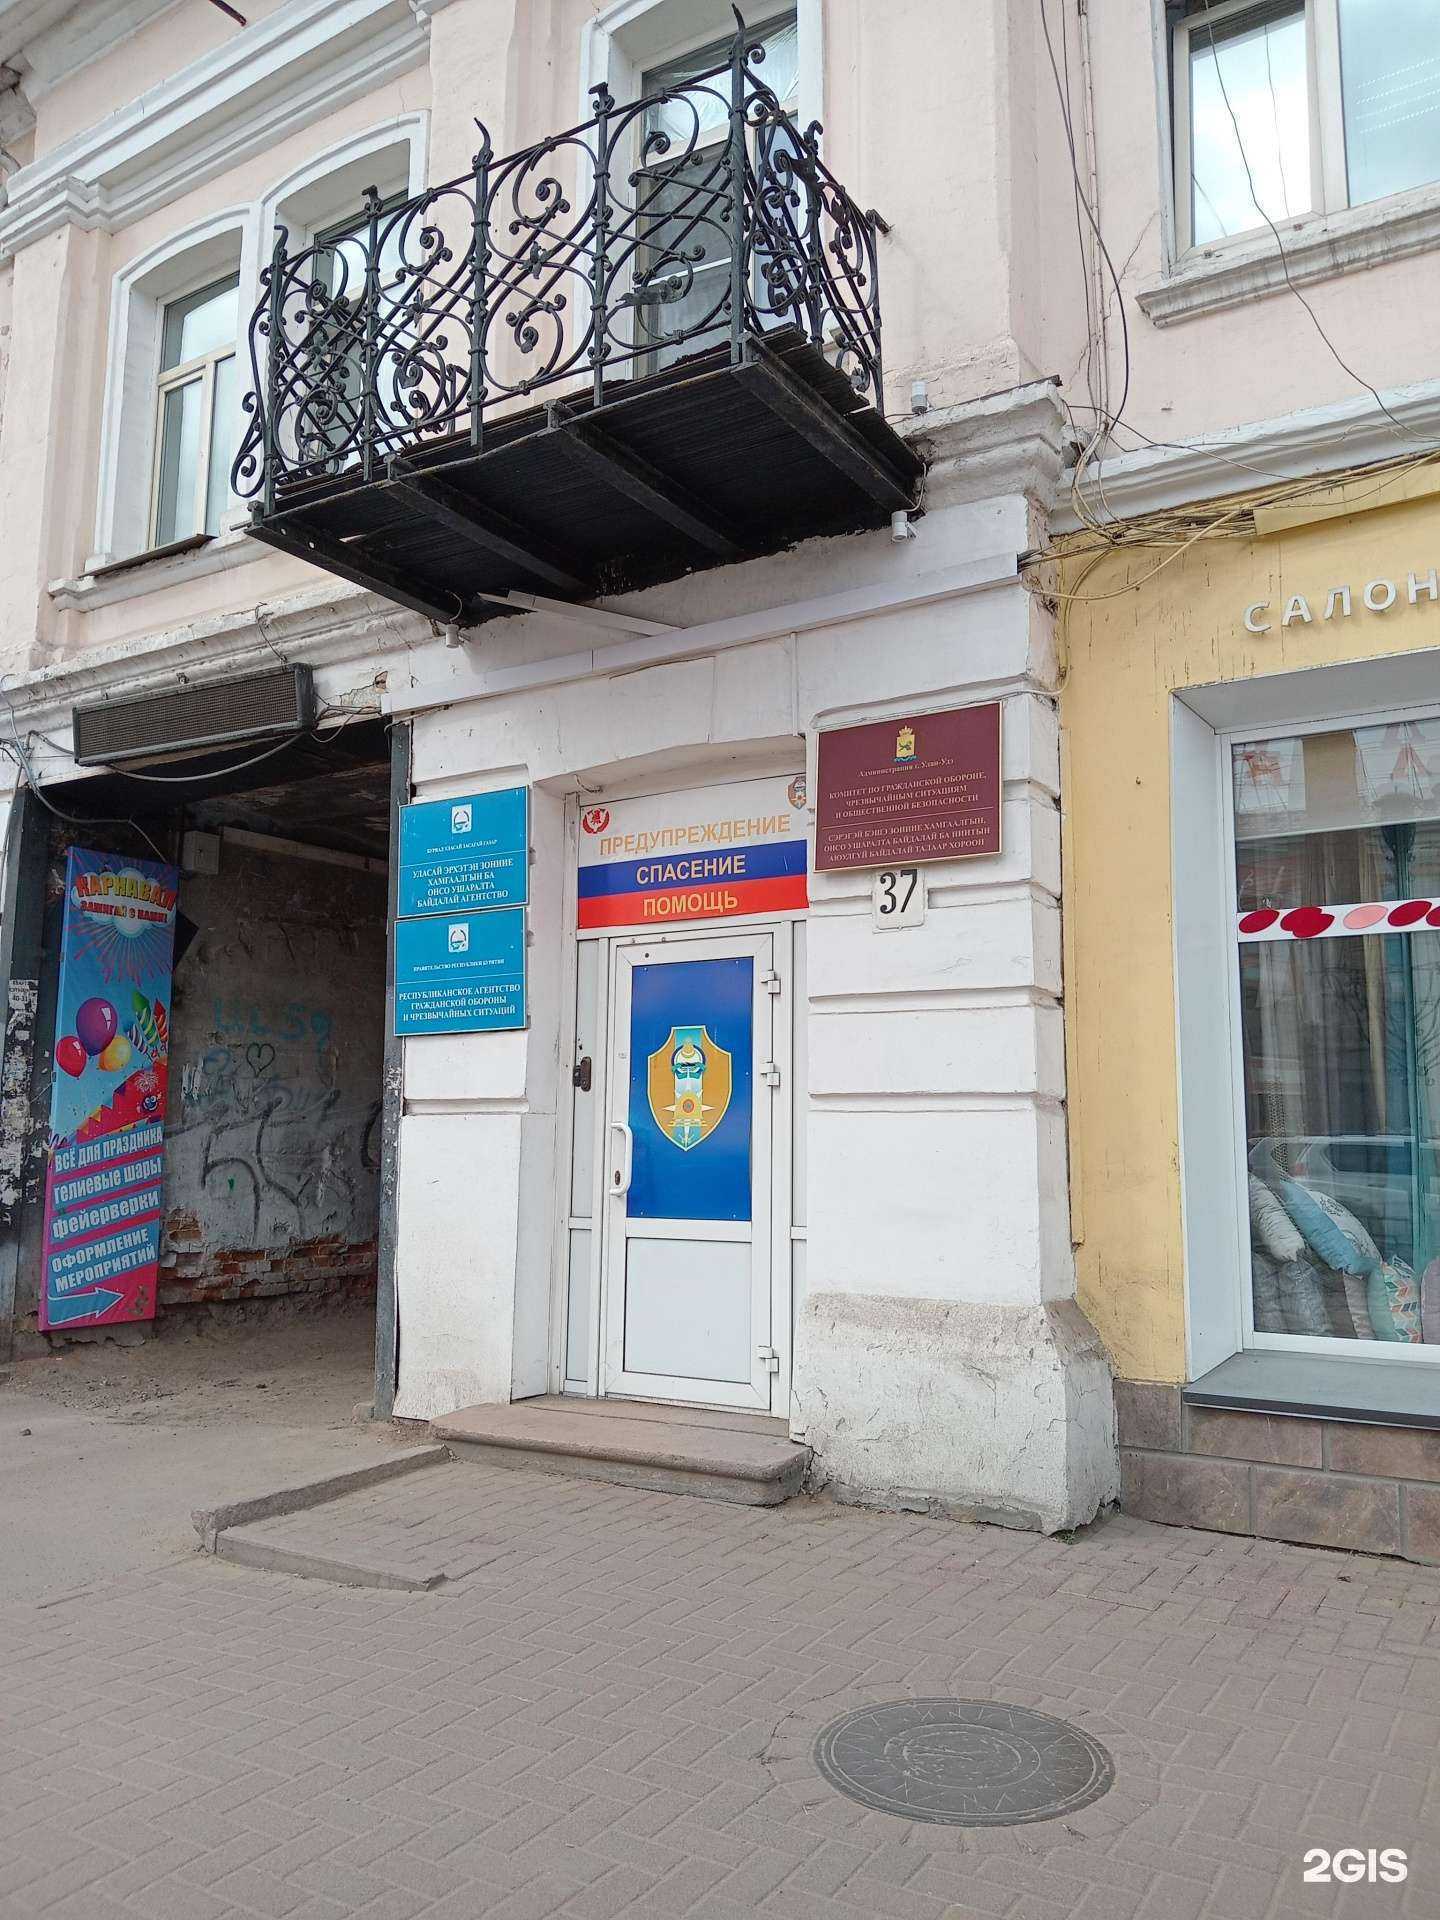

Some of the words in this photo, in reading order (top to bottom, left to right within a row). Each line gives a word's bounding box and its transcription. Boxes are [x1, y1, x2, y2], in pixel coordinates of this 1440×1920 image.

[1243, 568, 1440, 633] САЛОН
[858, 764, 913, 777] Администрация
[920, 758, 954, 769] Улан-Удэ
[829, 788, 866, 800] КОМИТЕТ
[868, 786, 878, 794] ПО
[880, 776, 942, 793] ГРАЖДАНСКОЙ
[944, 772, 987, 784] ОБОРОНЕ,
[846, 792, 912, 807] ЧРЕЗВЫЧАЙНЫМ
[914, 785, 967, 799] СИТУАЦИЯМ
[842, 802, 910, 818] ОБЩЕСТВЕННОЙ
[911, 794, 979, 810] БЕЗОПАСНОСТИ
[600, 814, 792, 856] ПРЕДУПРЕЖДЕНИЕ
[892, 832, 938, 845] БАЙДАЛАЙ
[869, 844, 912, 858] БАЙДАЛАЙ
[412, 866, 442, 878] УЛАСАЙ
[444, 864, 478, 874] ЭРХЭТЭН
[428, 872, 482, 886] ХАМГААЛГЫН
[636, 854, 746, 886] СПАСЕНИЕ
[76, 874, 178, 912] КАРНАВАЛ
[417, 895, 460, 908] БАЙДАЛАЙ
[461, 890, 508, 903] АГЕНТСТВО
[428, 887, 450, 896] ОНСО
[451, 882, 495, 894] УШАРАЛТА
[879, 869, 918, 914] 37
[642, 890, 738, 917] ПОМОЩЬ
[399, 987, 472, 1000] РЕСПУБЛИКАНСКОЕ
[474, 984, 520, 995] АГЕНТСТВО
[411, 997, 466, 1010] ГРАЖДАНСКОЙ
[468, 996, 506, 1005] ОБОРОНЫ
[410, 1008, 472, 1020] ЧРЕЗВЫЧАЙНЫХ
[474, 1004, 516, 1016] СИТУАЦИЙ
[55, 1148, 76, 1172] ВСЁ
[78, 1143, 101, 1166] ДЛЯ
[103, 1126, 163, 1159] ПРАЗДНИКА
[51, 1227, 150, 1273] ОФОРМЛЕНИЕ
[54, 1241, 156, 1293] МЕРОПРИЯТИЙ
